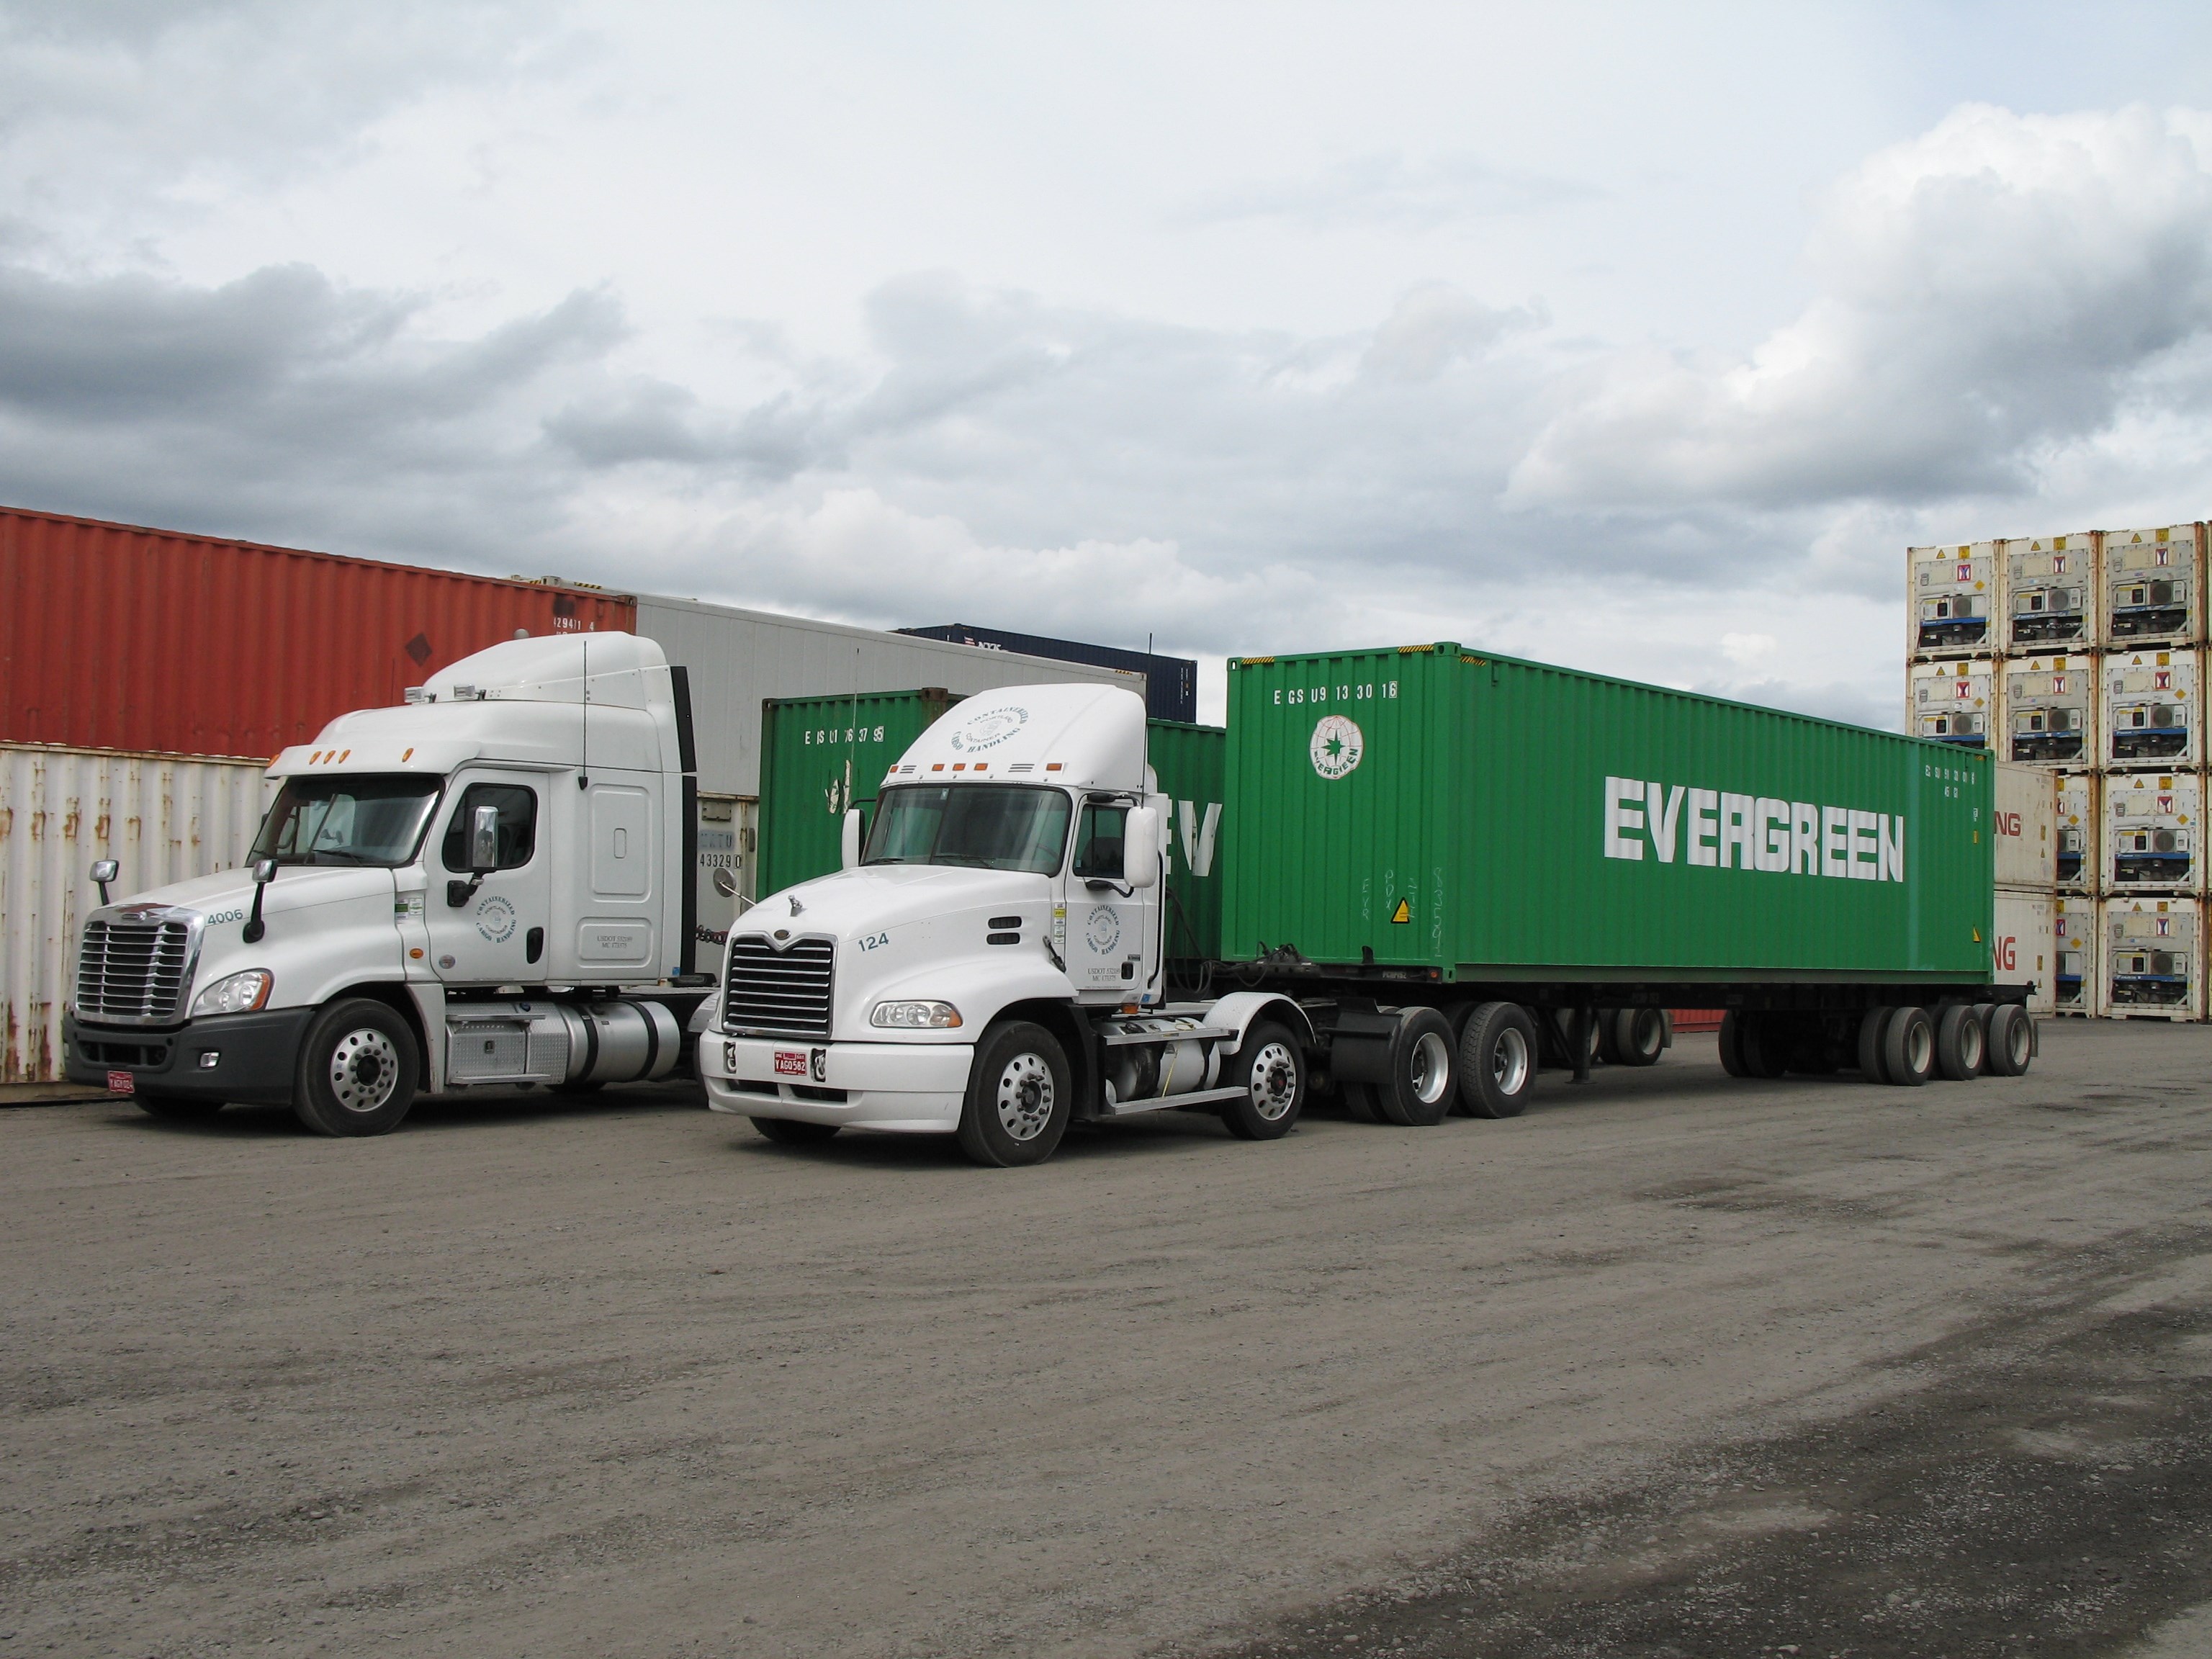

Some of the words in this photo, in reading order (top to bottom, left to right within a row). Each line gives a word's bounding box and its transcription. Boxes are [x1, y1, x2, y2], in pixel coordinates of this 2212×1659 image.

[966, 727, 1020, 752] HANDLING
[1604, 776, 1904, 883] EVERGREEN
[700, 854, 732, 868] 43329
[207, 909, 243, 925] 4006
[858, 932, 889, 952] 124
